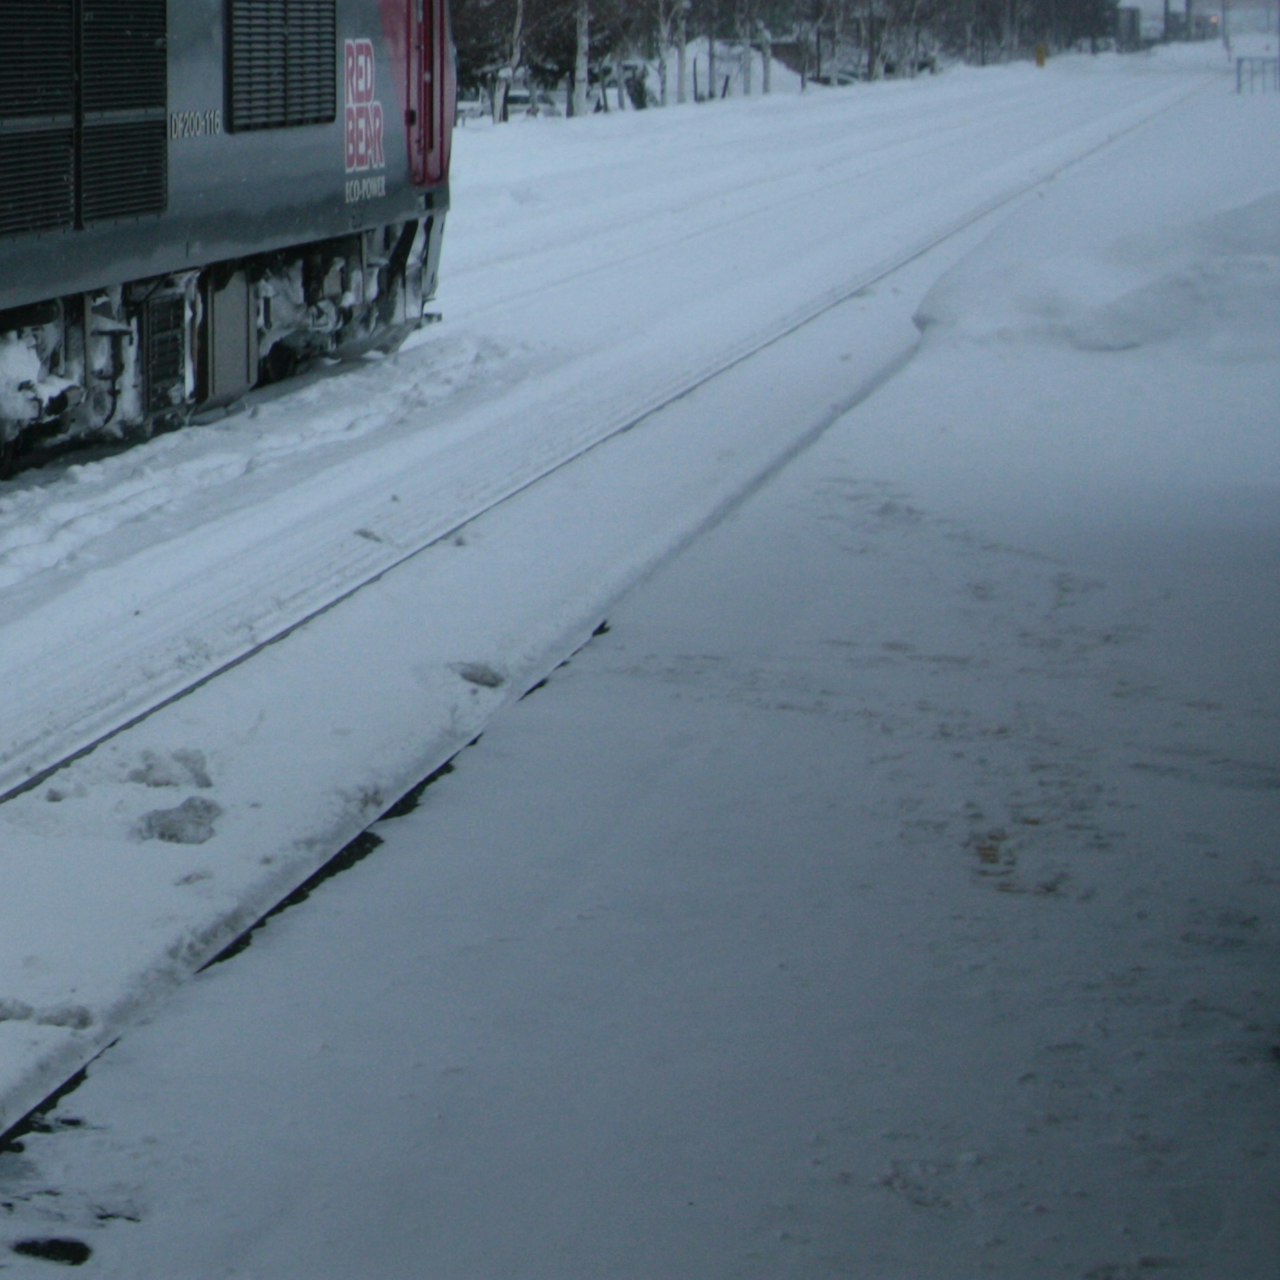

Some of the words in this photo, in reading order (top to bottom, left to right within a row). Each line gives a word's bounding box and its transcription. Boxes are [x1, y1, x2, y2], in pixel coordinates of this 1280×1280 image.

[344, 38, 376, 105] RED
[170, 107, 221, 140] DF200-116
[344, 101, 386, 173] BEAR
